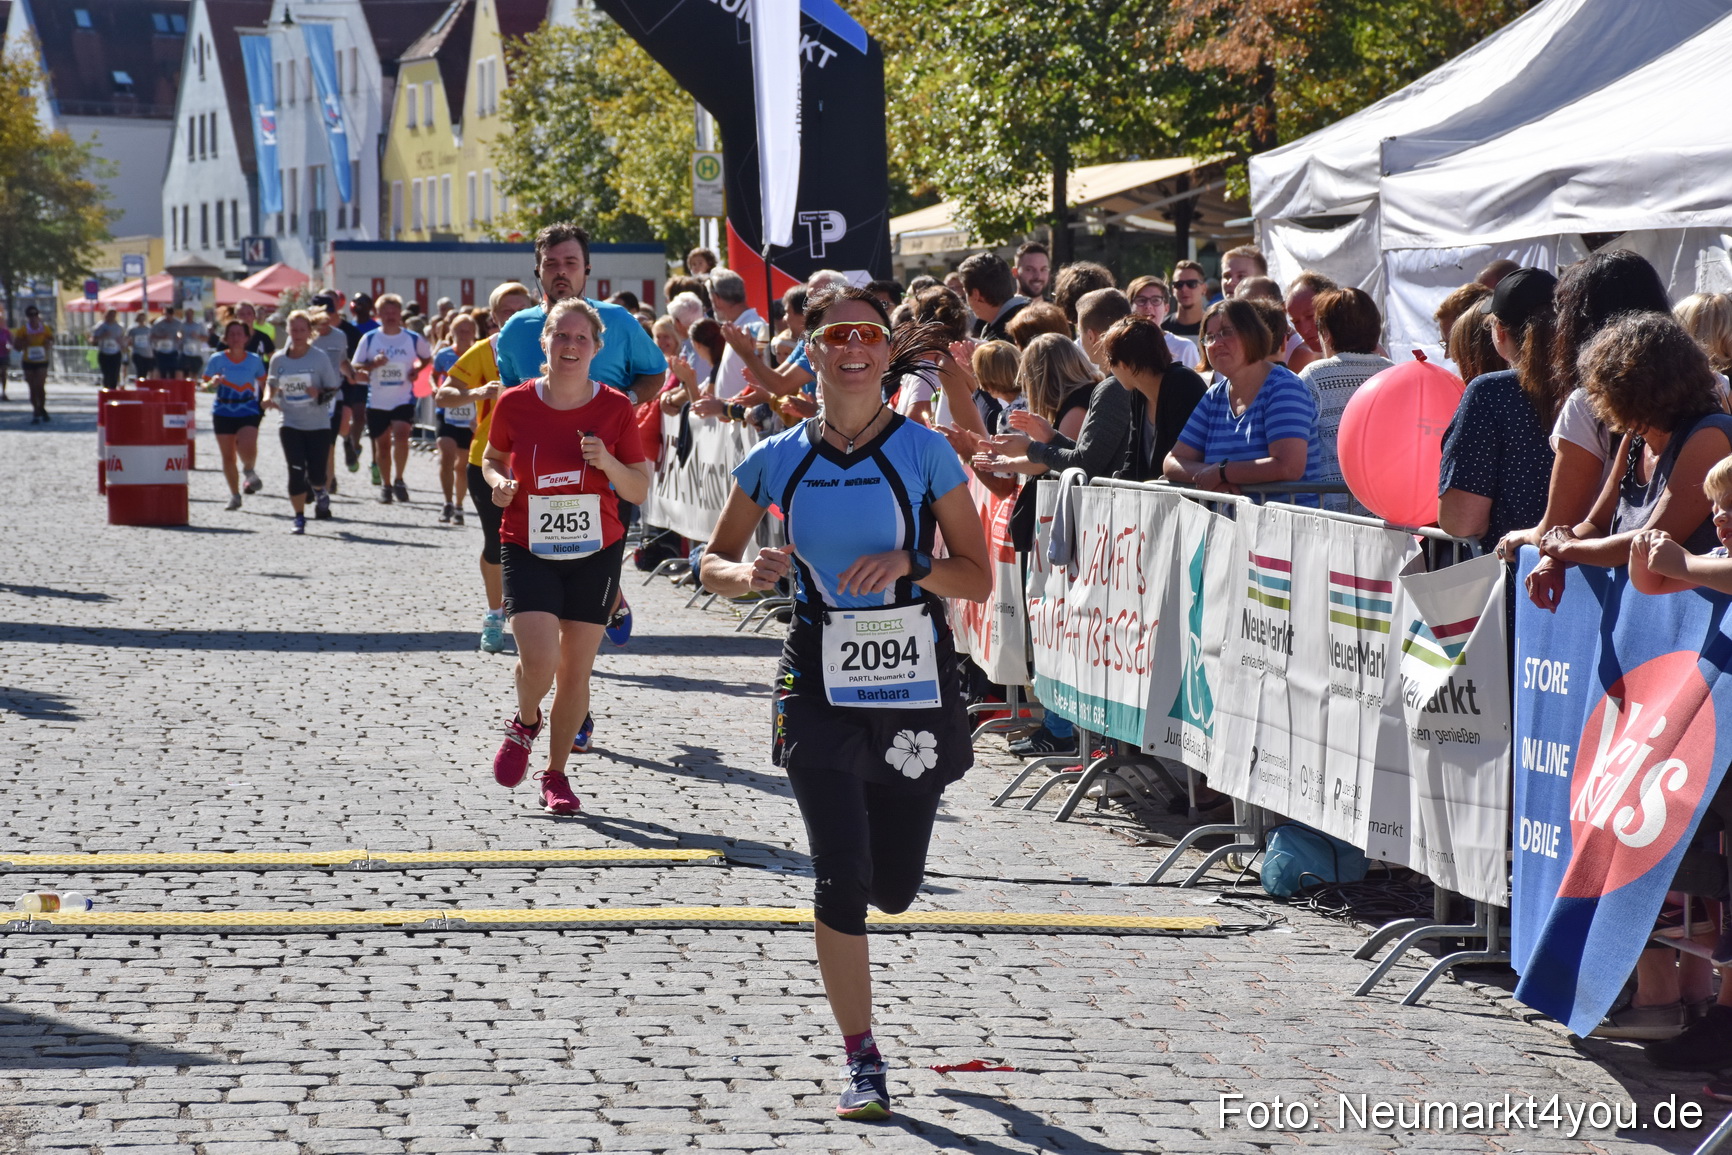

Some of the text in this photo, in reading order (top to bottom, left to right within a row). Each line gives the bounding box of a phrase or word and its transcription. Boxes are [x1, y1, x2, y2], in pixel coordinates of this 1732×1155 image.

[549, 475, 569, 484] DEHN
[549, 499, 580, 508] BOCK
[540, 511, 590, 533] 2453
[552, 543, 580, 553] Nicole
[855, 618, 904, 632] BOCK
[840, 635, 920, 671] 2094
[873, 673, 906, 681] Neumarkt
[1523, 656, 1570, 695] STORE
[857, 688, 910, 701] Barbara
[1164, 726, 1182, 747] Jura
[1434, 726, 1481, 745] genießen
[1521, 736, 1570, 778] ONLINE
